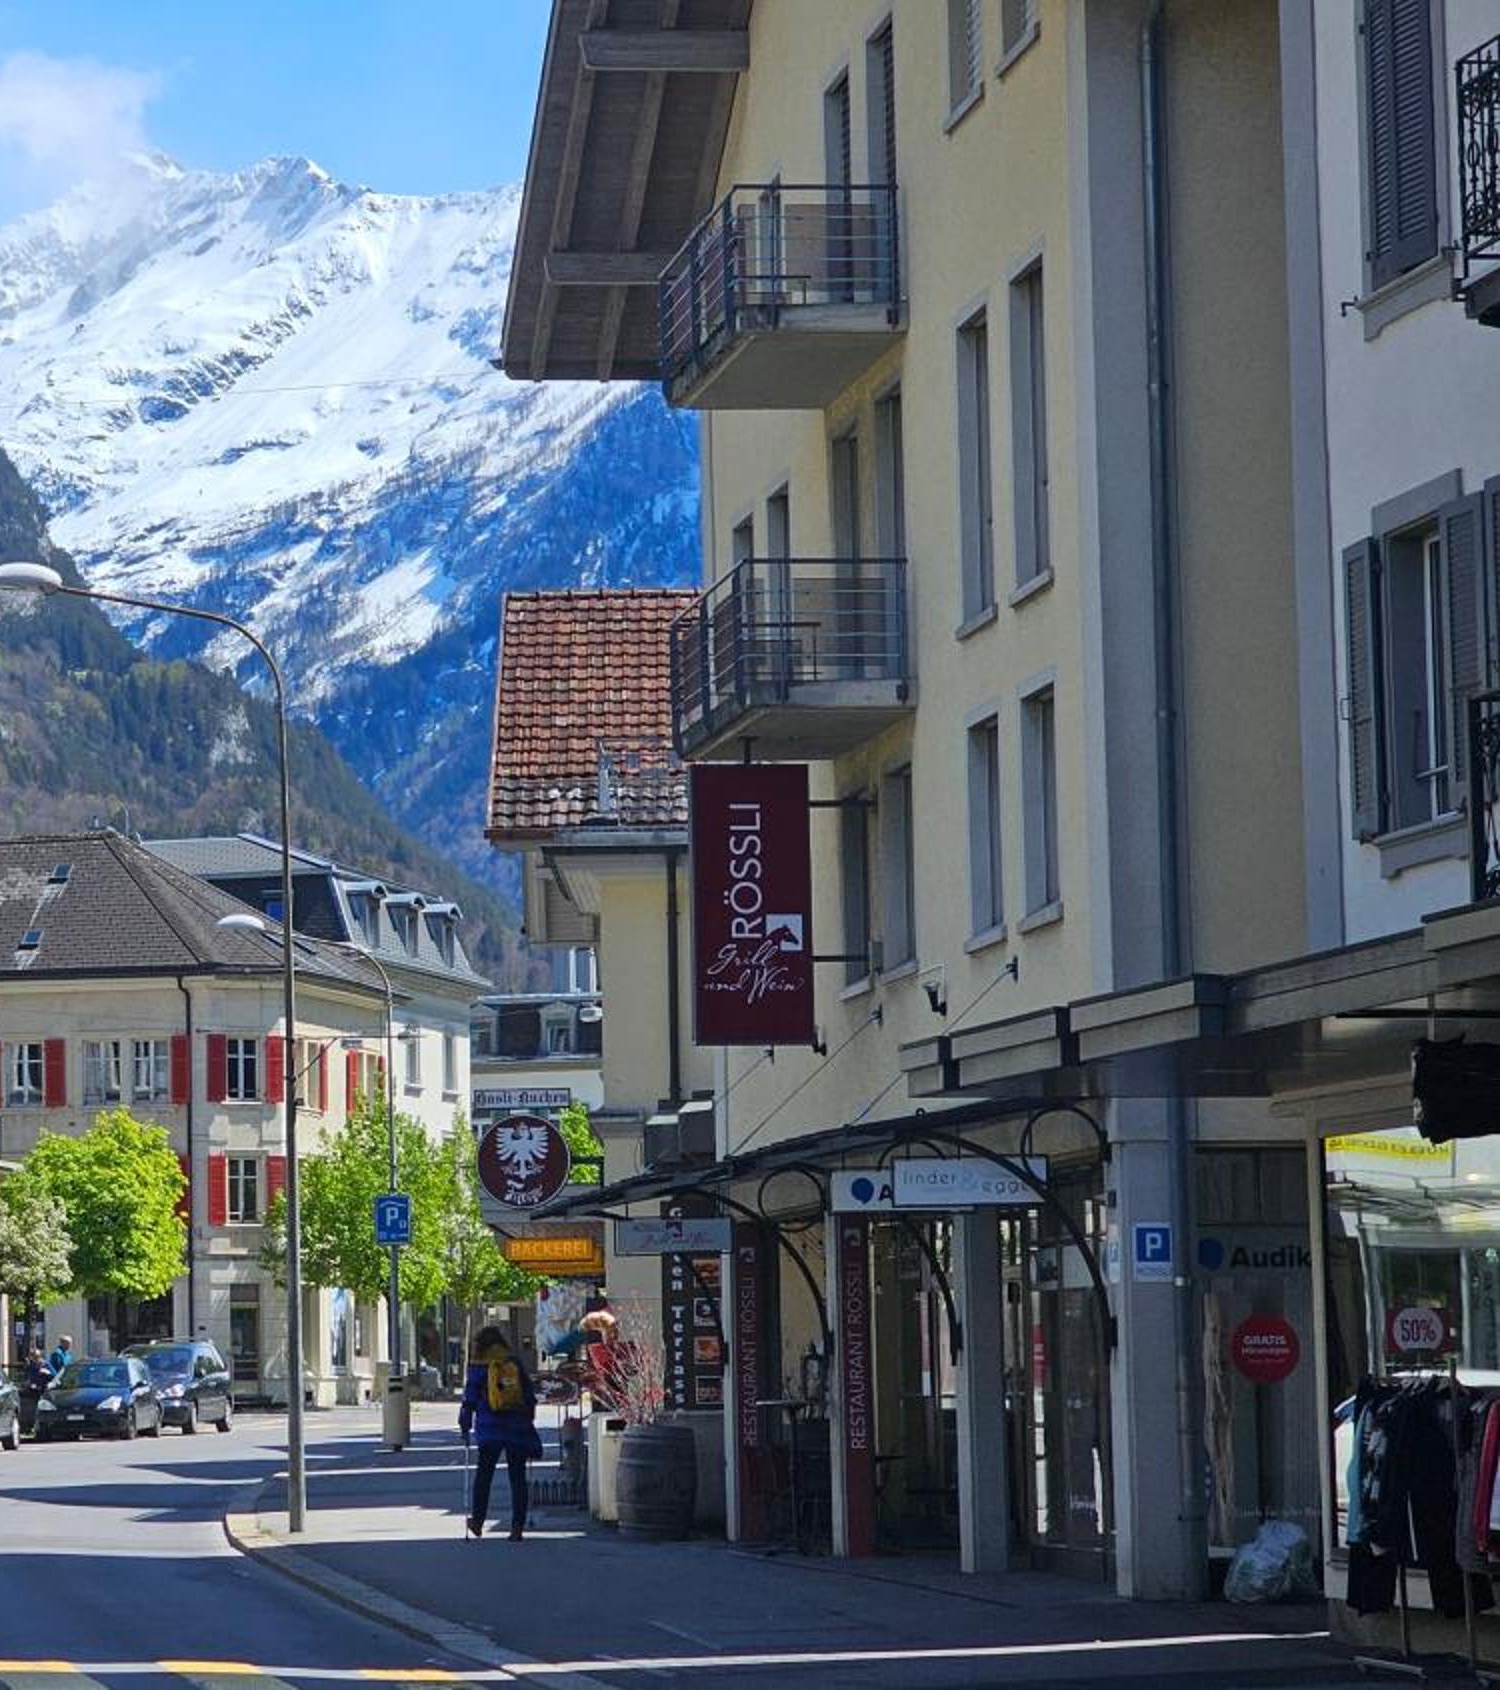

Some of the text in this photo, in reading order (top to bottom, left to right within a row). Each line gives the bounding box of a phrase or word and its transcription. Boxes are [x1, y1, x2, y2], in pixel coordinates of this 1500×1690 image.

[723, 802, 763, 939] RÖSSLI
[386, 1207, 399, 1227] P
[1145, 1232, 1163, 1258] P
[1230, 1246, 1312, 1268] Audik
[1401, 1318, 1437, 1343] 50%
[848, 1331, 867, 1450] RESTAURANT
